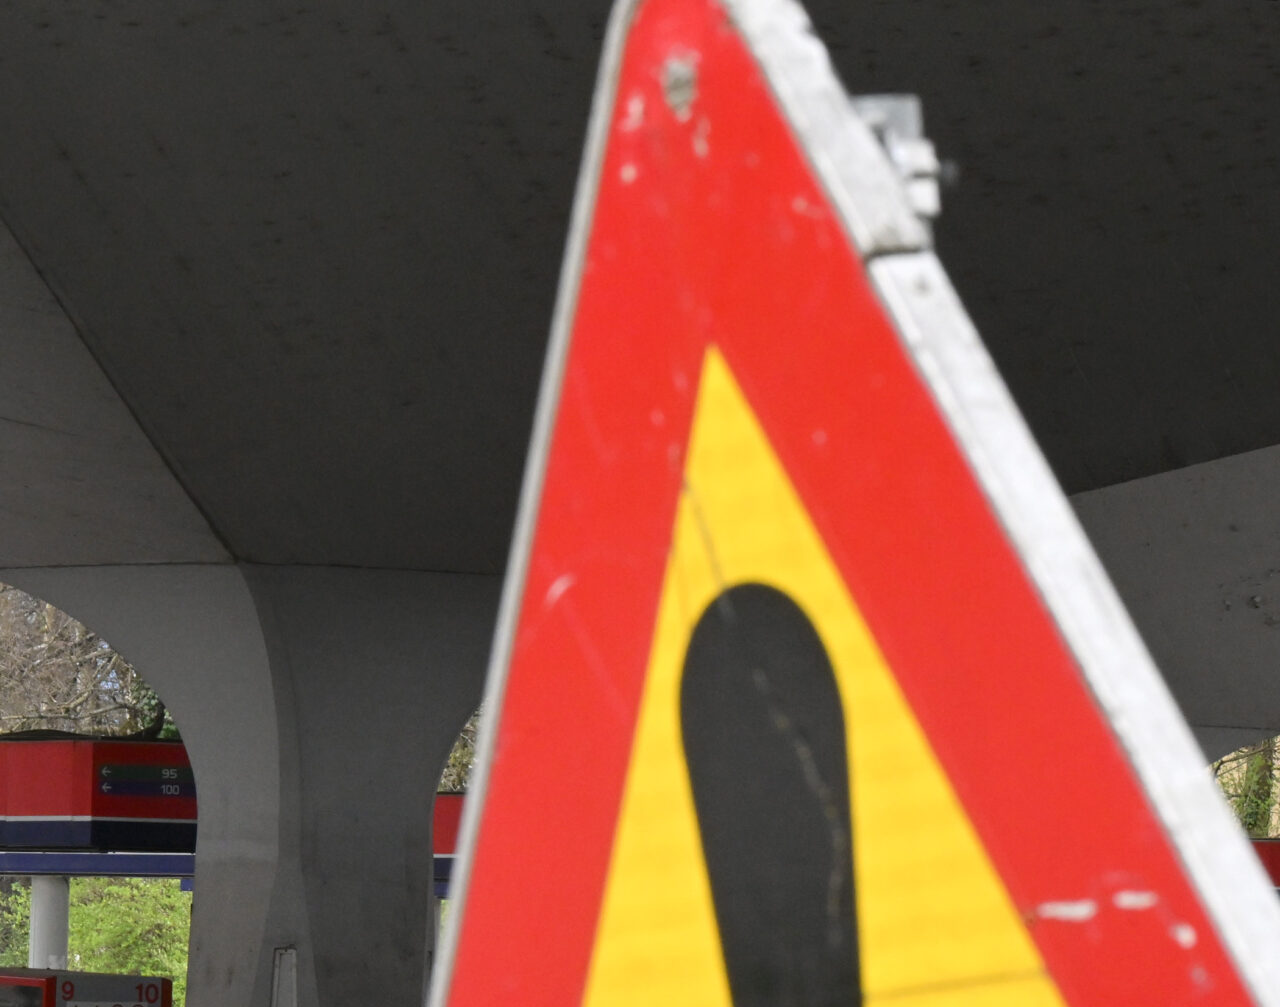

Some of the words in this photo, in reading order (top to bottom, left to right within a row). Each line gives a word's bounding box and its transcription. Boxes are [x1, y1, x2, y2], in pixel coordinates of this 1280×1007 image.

[161, 768, 178, 779] 95
[160, 784, 180, 795] 100
[61, 981, 75, 1001] 9
[136, 983, 160, 1004] 10
